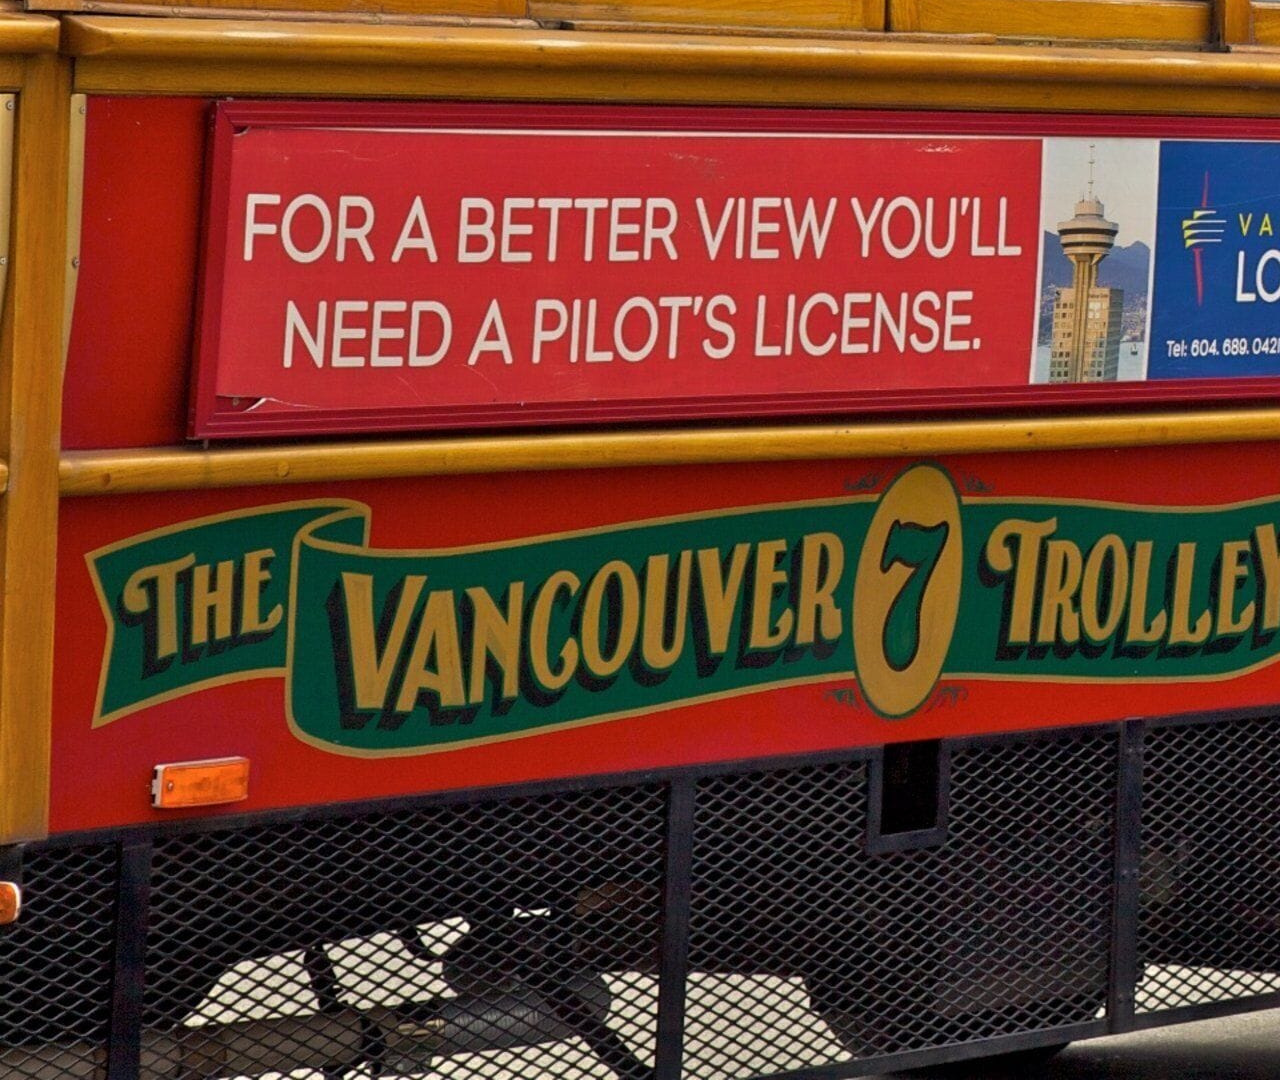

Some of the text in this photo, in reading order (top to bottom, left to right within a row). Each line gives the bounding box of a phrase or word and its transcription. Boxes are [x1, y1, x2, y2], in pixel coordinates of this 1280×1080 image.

[243, 193, 1022, 263] FOR A BETTER VIEW YOU'LL
[283, 289, 982, 370] NEED A PILOT'S LICENSE.
[1166, 340, 1188, 358] Tel:
[1191, 338, 1220, 357] 604.
[1222, 337, 1250, 356] 689.
[1252, 337, 1280, 355] 0421
[122, 546, 284, 662] THE
[337, 531, 844, 718] VANCOUVER
[880, 518, 950, 673] 7
